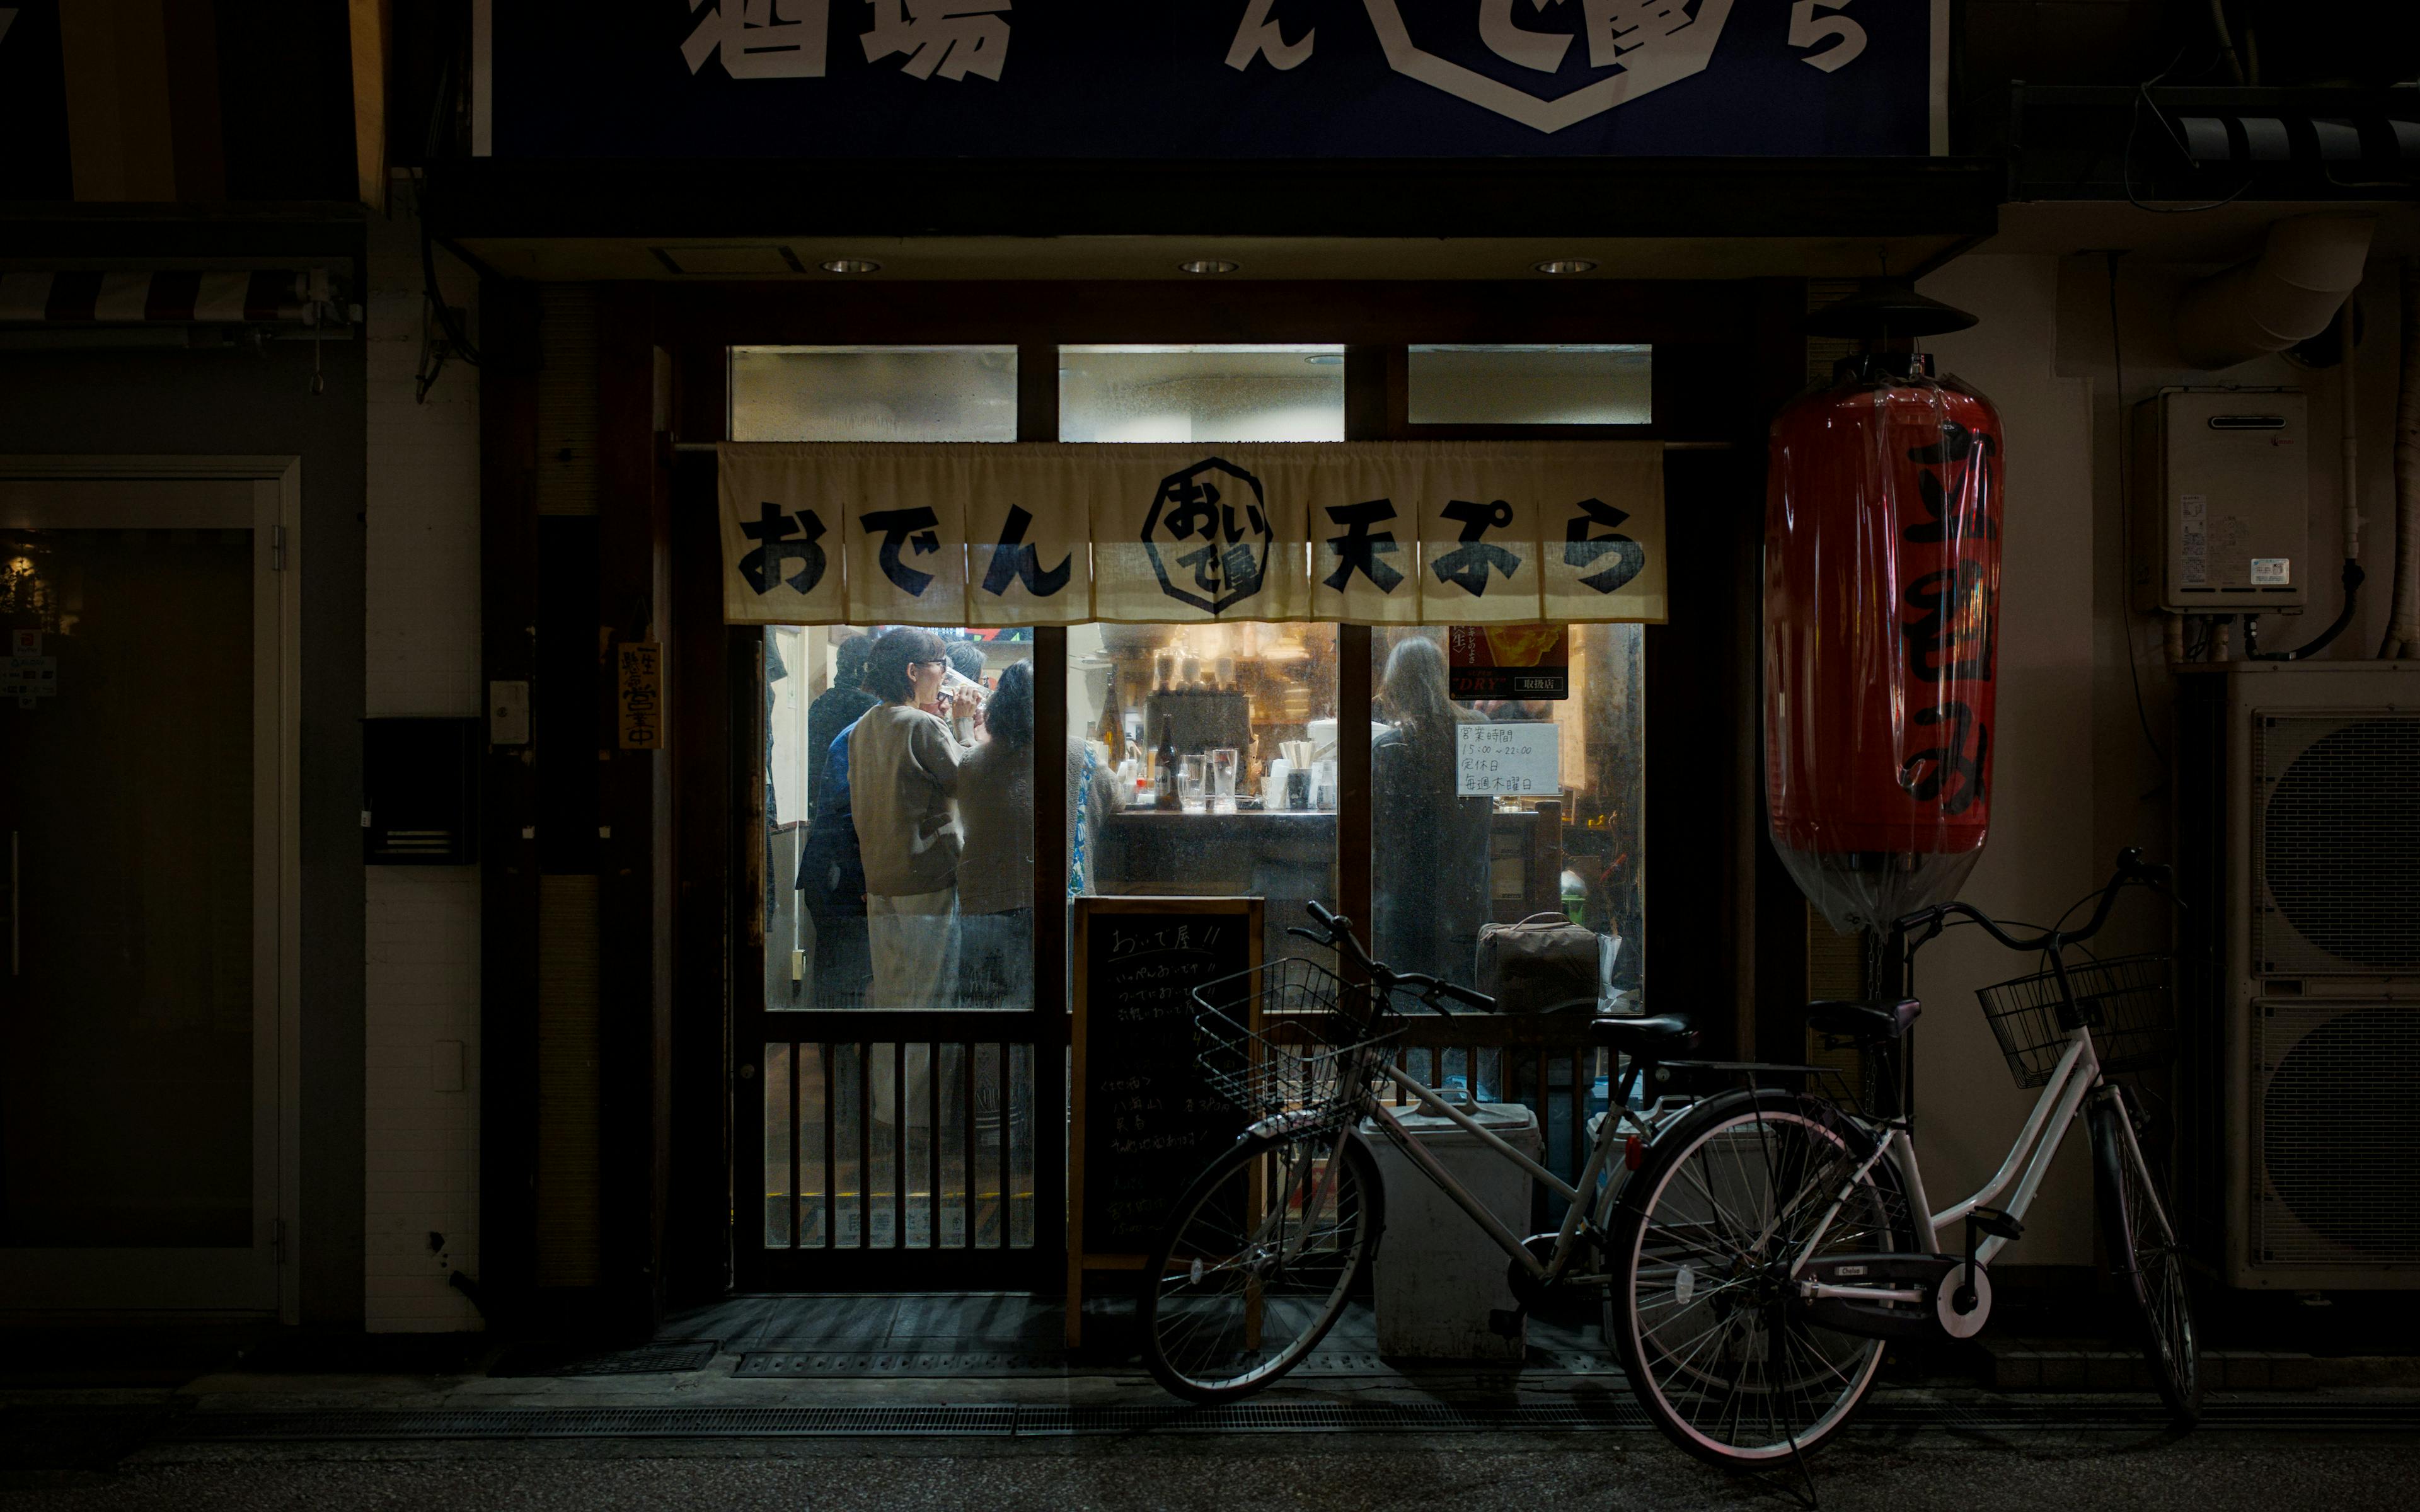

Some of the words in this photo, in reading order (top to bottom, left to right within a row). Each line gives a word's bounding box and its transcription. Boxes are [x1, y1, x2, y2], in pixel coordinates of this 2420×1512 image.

[739, 501, 1071, 597] おでん
[1323, 498, 1645, 597] 天ぷら
[1523, 679, 1555, 689] 取扱店
[1460, 726, 1512, 743] 営業時間
[1461, 758, 1499, 772] 定休日
[1465, 774, 1531, 791] 毎週木曜日
